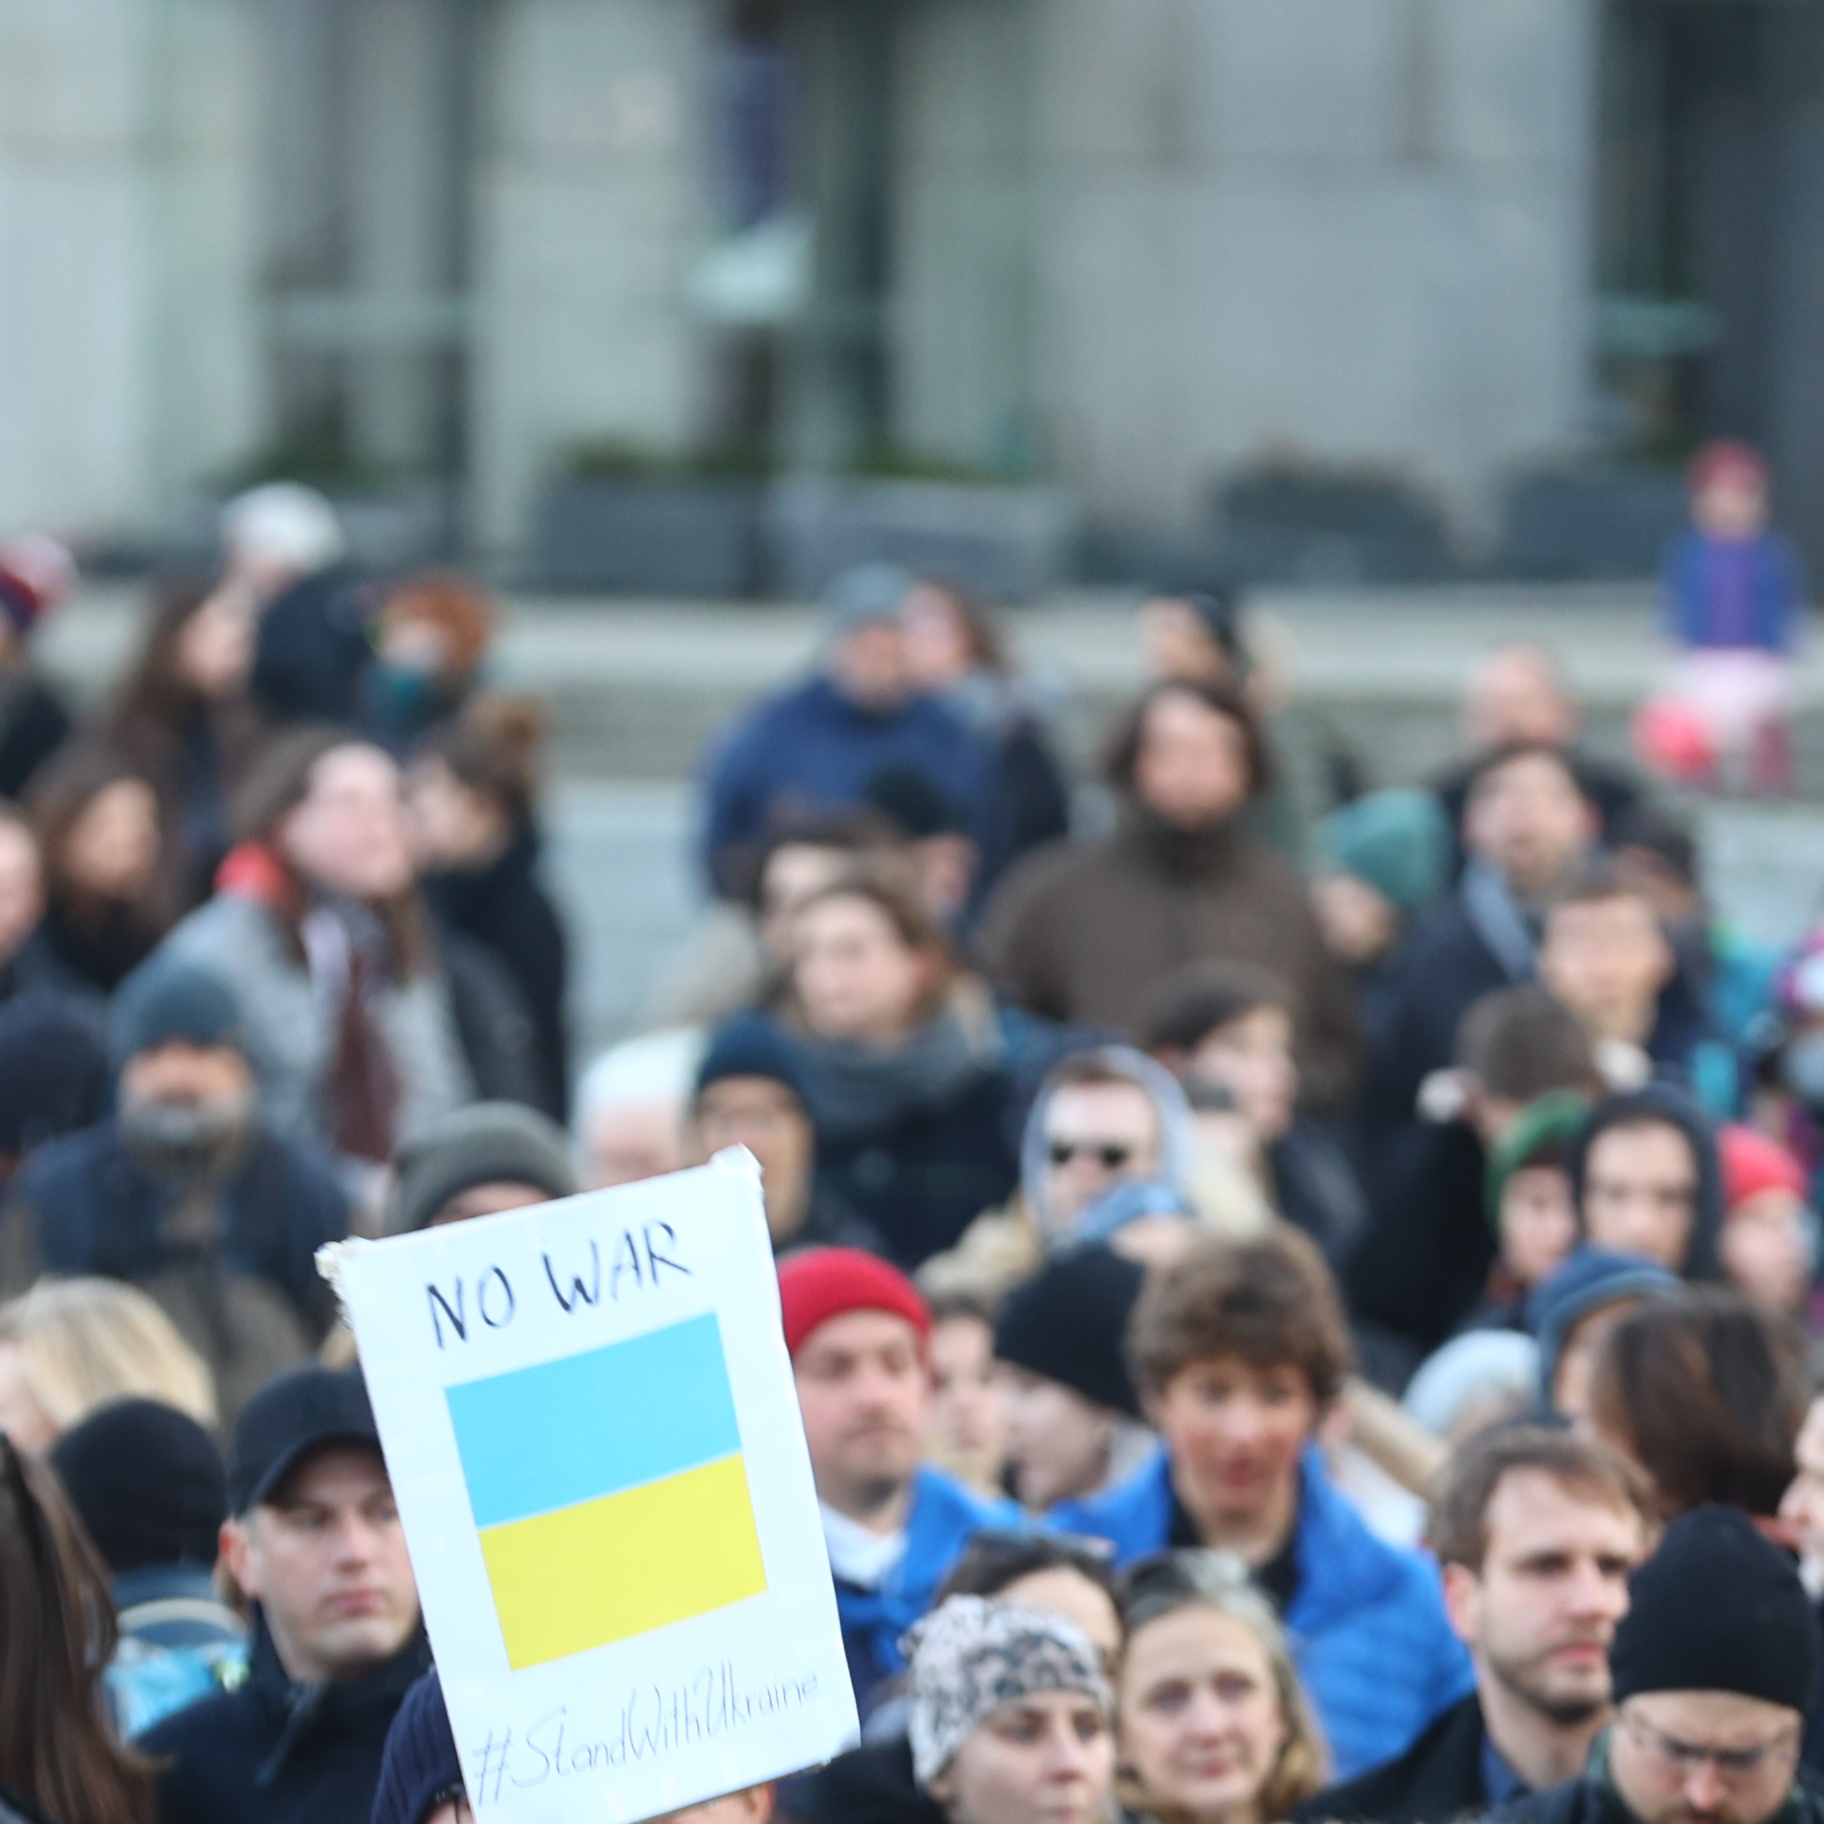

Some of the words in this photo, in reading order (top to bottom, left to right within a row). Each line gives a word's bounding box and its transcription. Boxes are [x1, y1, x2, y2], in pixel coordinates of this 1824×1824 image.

[424, 1262, 515, 1351] NO
[541, 1219, 693, 1316] WAR
[470, 1659, 821, 1809] #StandWithUkraine
